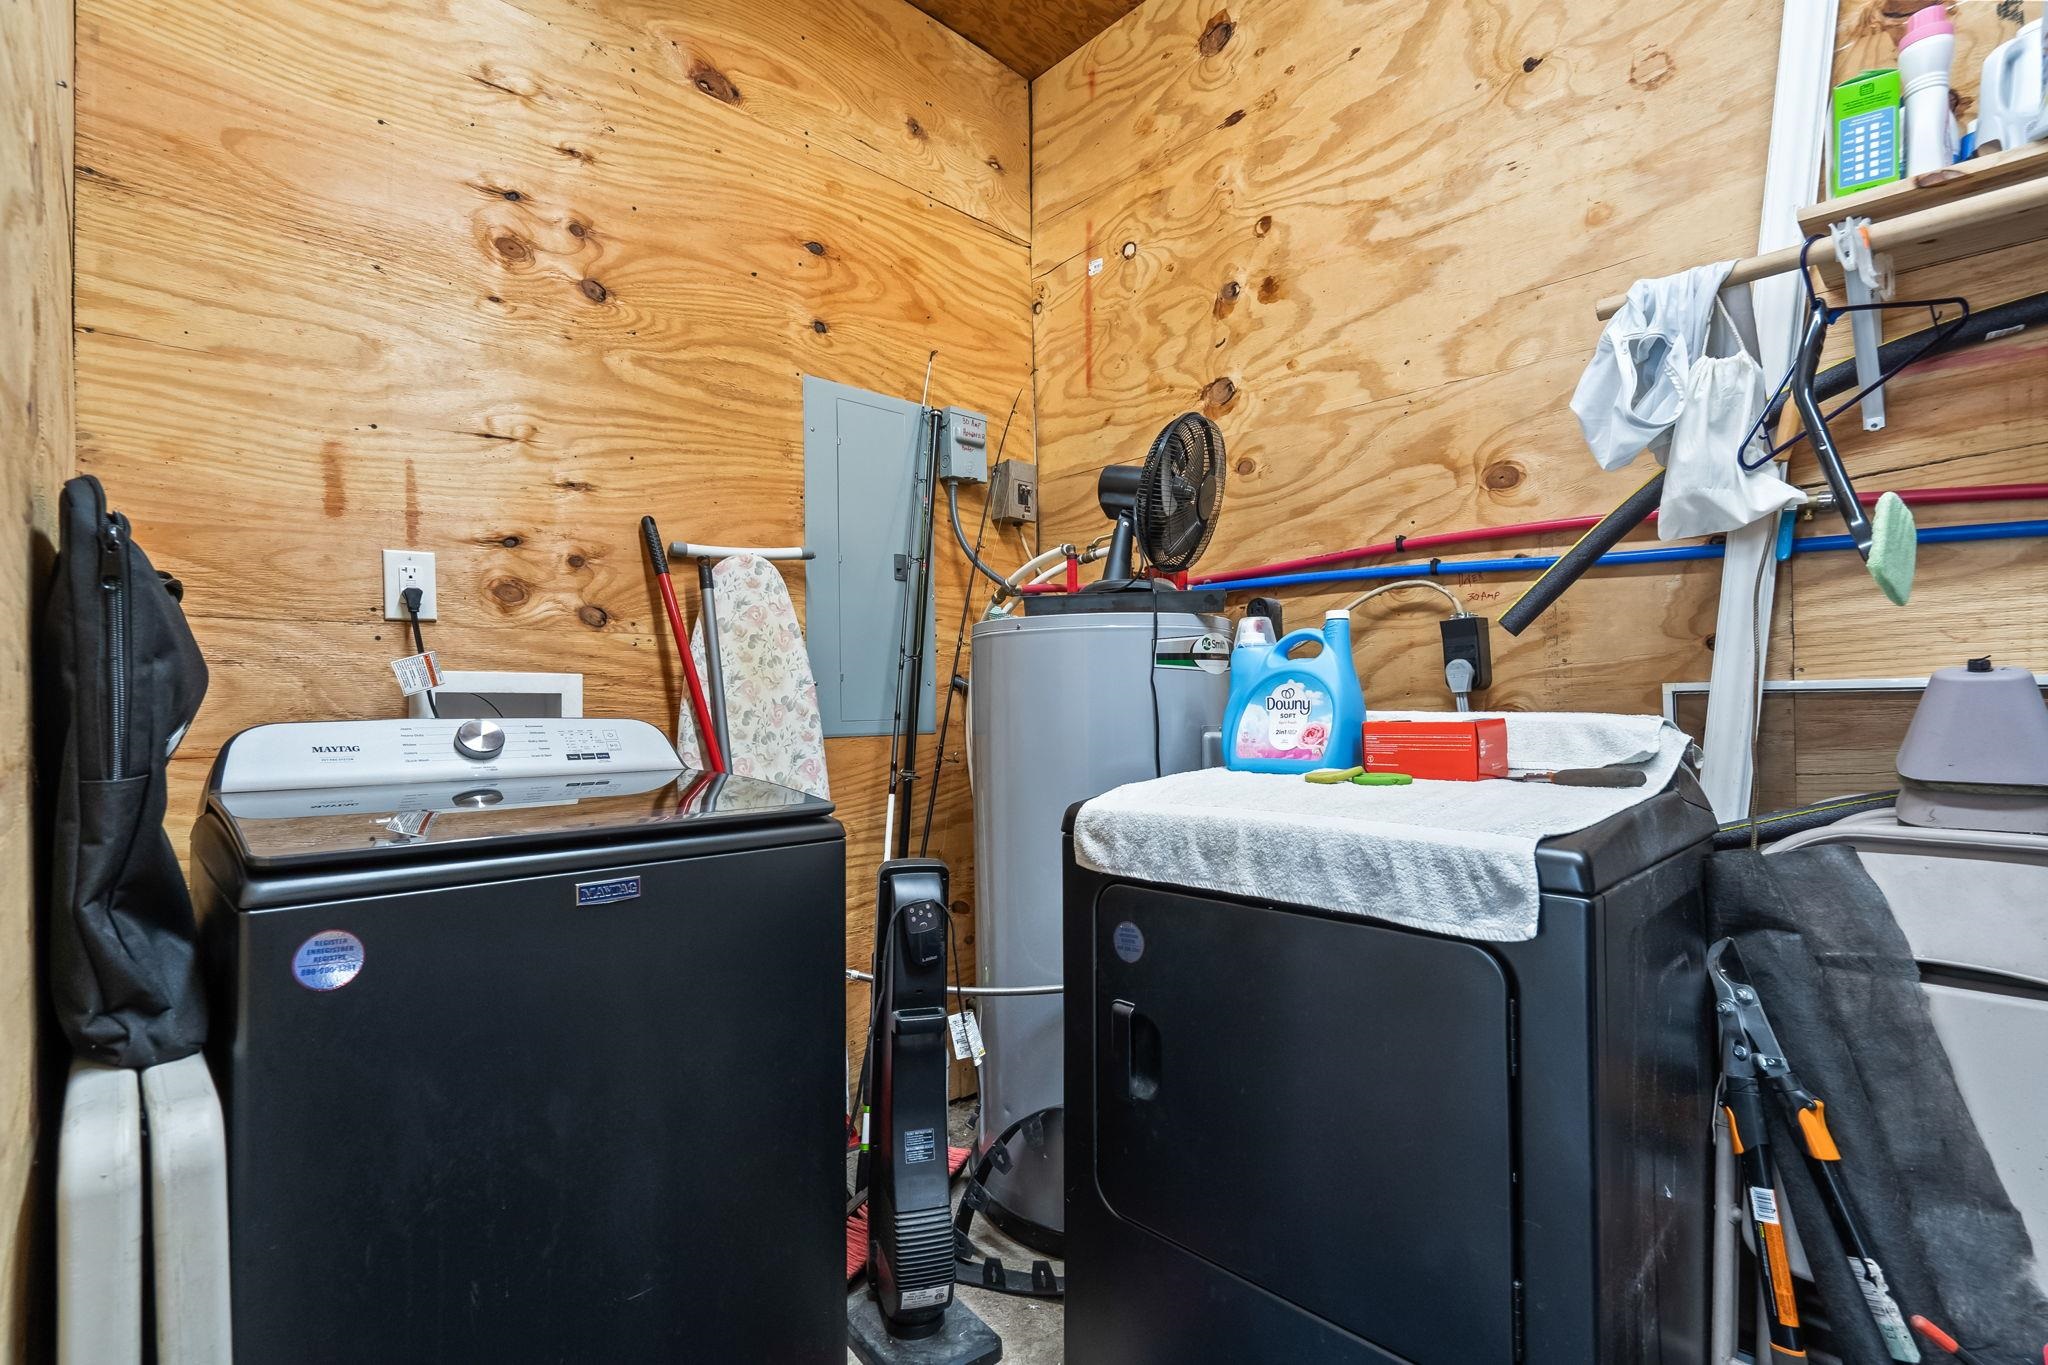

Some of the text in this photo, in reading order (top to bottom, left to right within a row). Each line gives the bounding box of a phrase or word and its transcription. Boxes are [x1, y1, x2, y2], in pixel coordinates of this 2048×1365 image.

[1467, 593, 1479, 602] 30
[1267, 697, 1311, 715] Downy
[580, 882, 637, 901] MAYTAG
